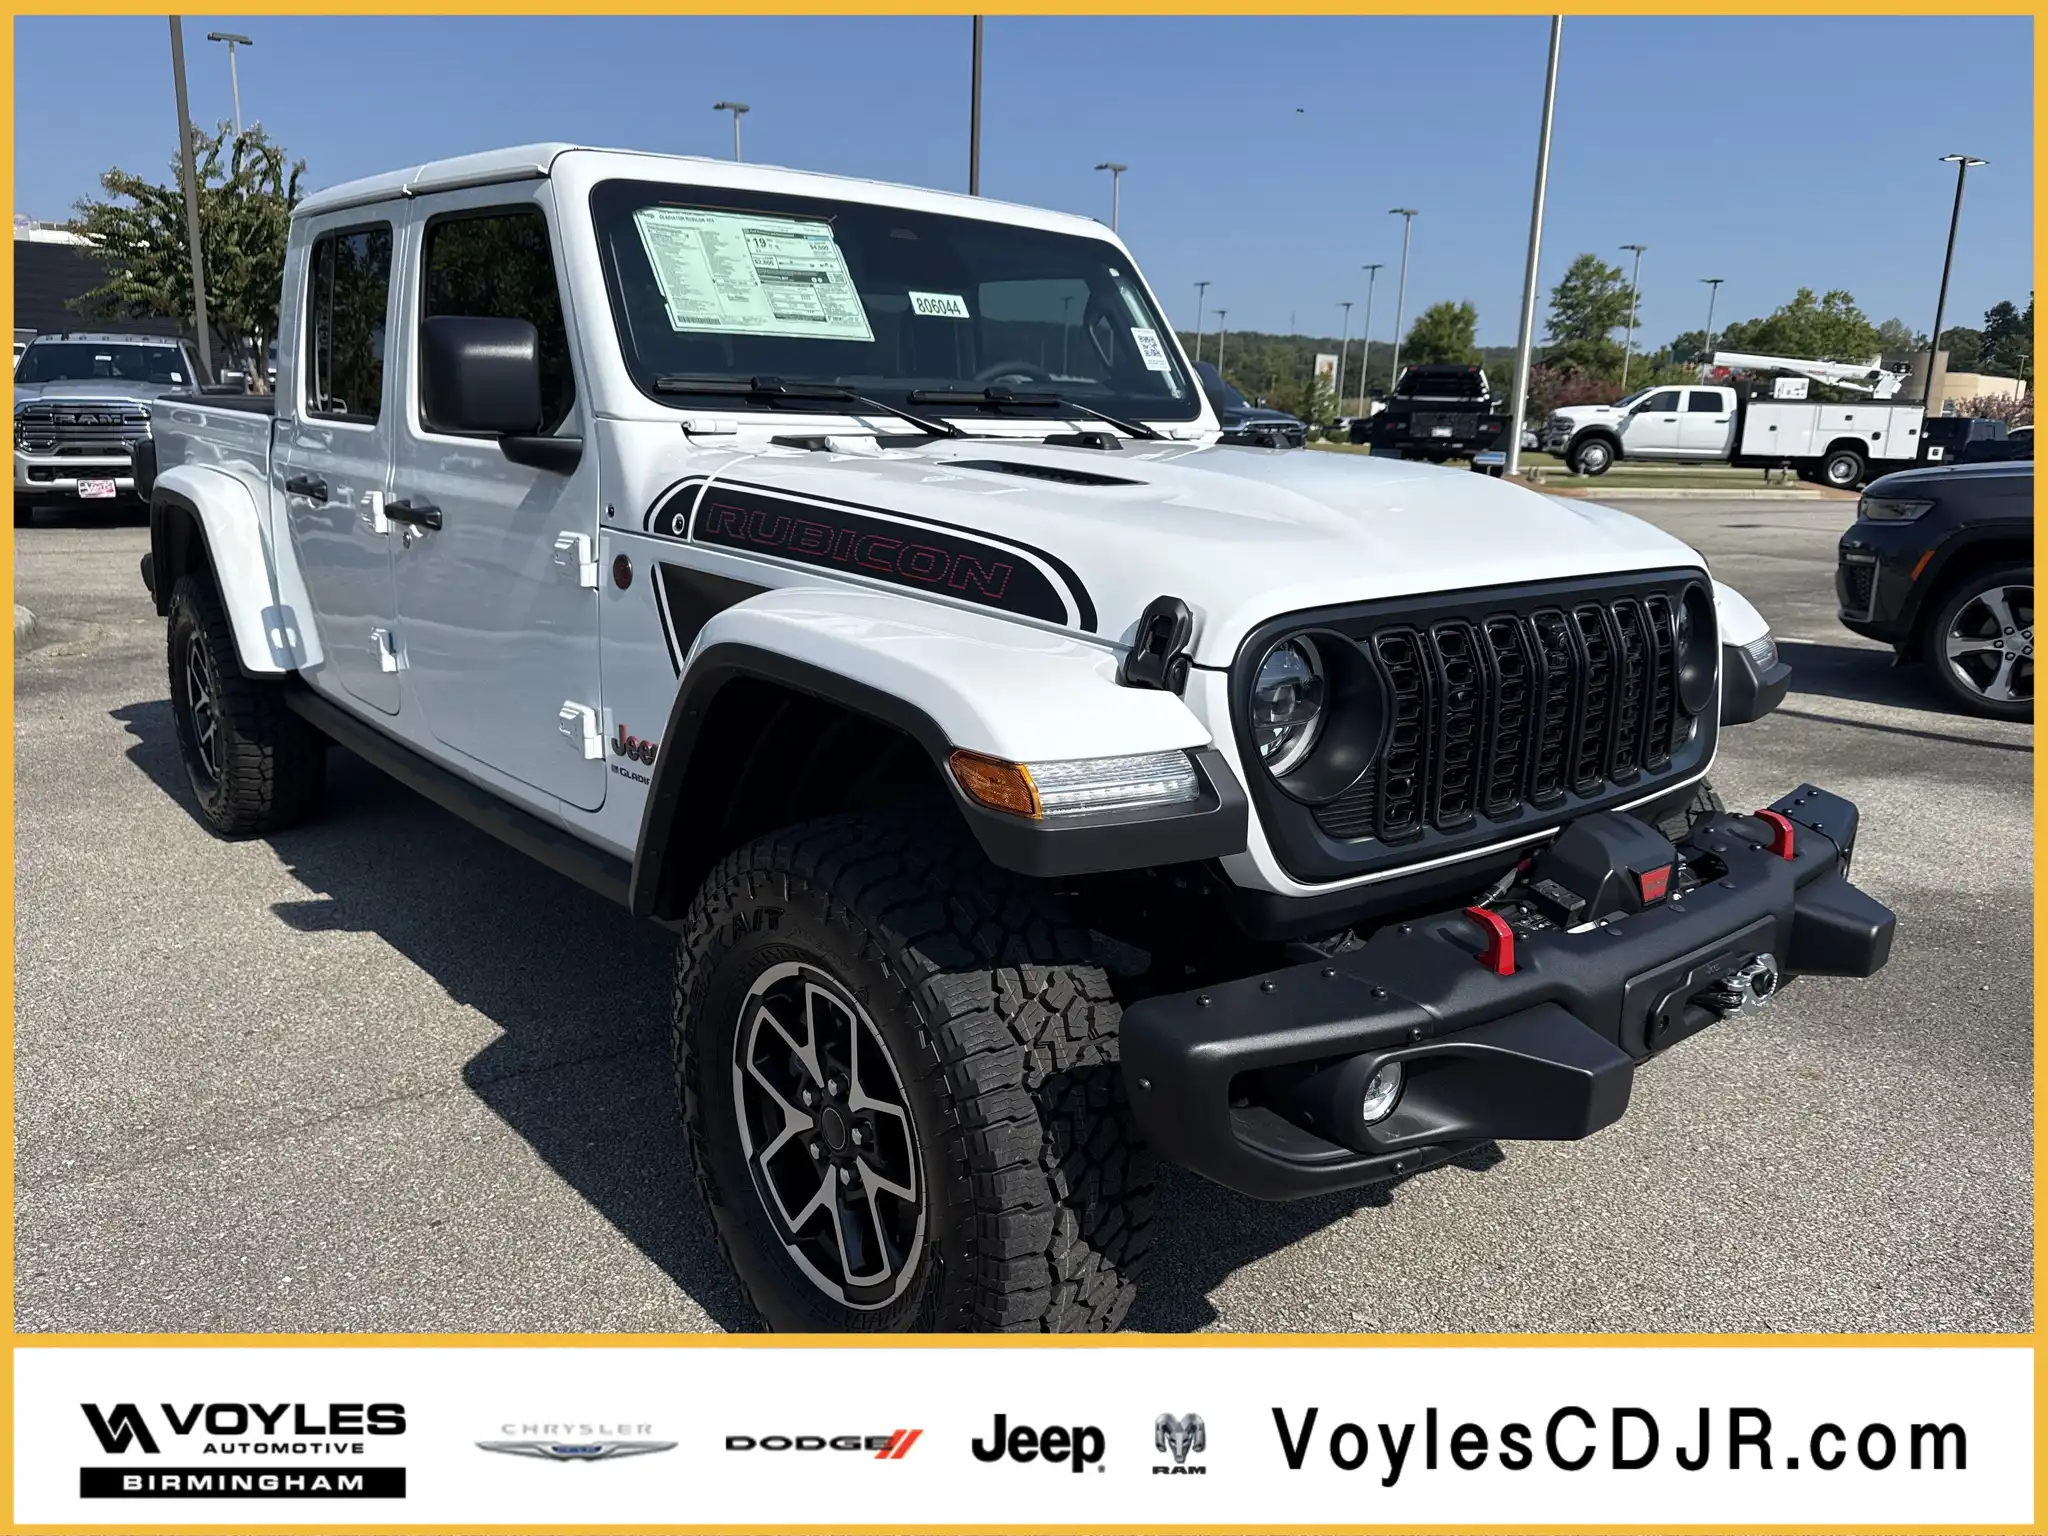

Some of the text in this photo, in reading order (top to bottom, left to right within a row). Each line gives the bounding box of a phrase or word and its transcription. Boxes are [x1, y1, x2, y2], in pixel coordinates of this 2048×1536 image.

[752, 237, 767, 249] 19
[916, 297, 961, 315] 806044
[54, 413, 121, 424] RAM
[705, 503, 1014, 599] RUBICON
